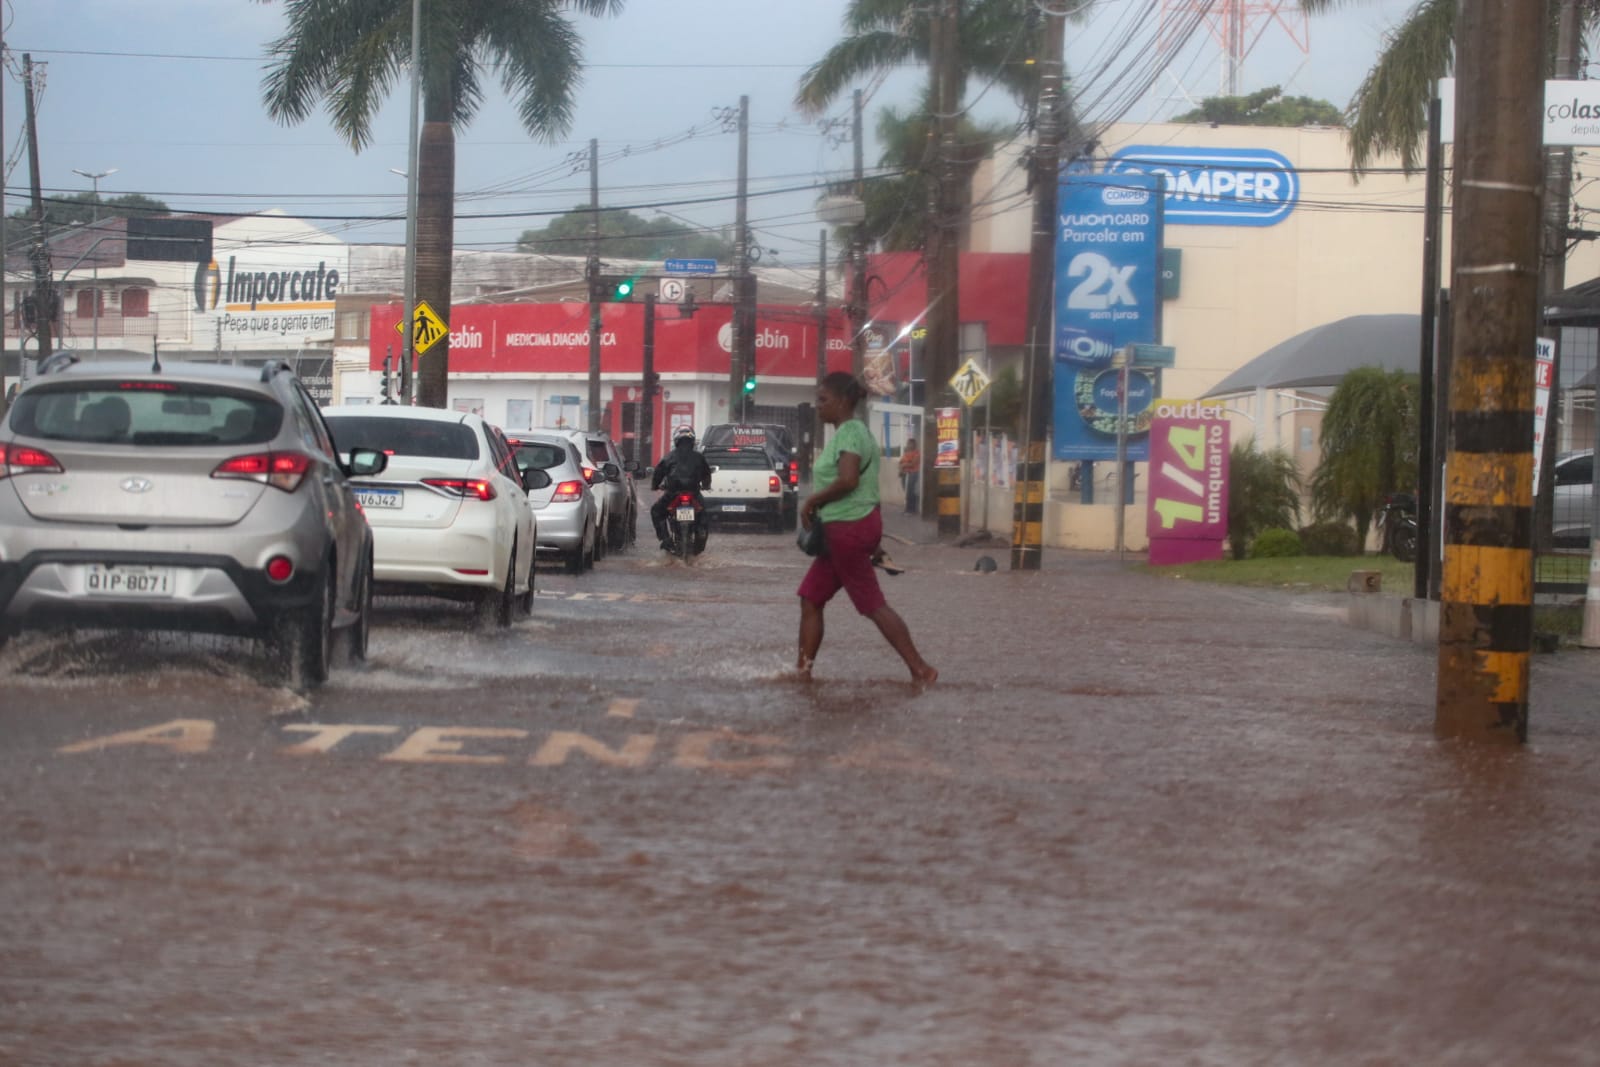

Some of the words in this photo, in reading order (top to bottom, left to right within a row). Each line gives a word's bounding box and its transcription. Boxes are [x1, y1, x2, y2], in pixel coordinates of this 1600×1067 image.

[1106, 190, 1146, 200] COMPER
[1123, 168, 1281, 203] OMPER
[1063, 228, 1118, 242] Parcela
[1122, 231, 1145, 242] em
[226, 256, 339, 311] Imporcate
[224, 313, 248, 334] Peça
[250, 317, 270, 335] que
[272, 319, 279, 331] a
[281, 314, 308, 335] gente
[1089, 311, 1111, 320] sem
[1112, 309, 1139, 321] juros
[448, 325, 482, 349] sabin
[506, 332, 550, 346] MEDICINA
[553, 330, 616, 346] DIAGNÓICA
[755, 328, 789, 349] abin
[1157, 402, 1224, 420] outlet
[1154, 424, 1206, 529] 1/4
[1208, 425, 1224, 524] umquarto
